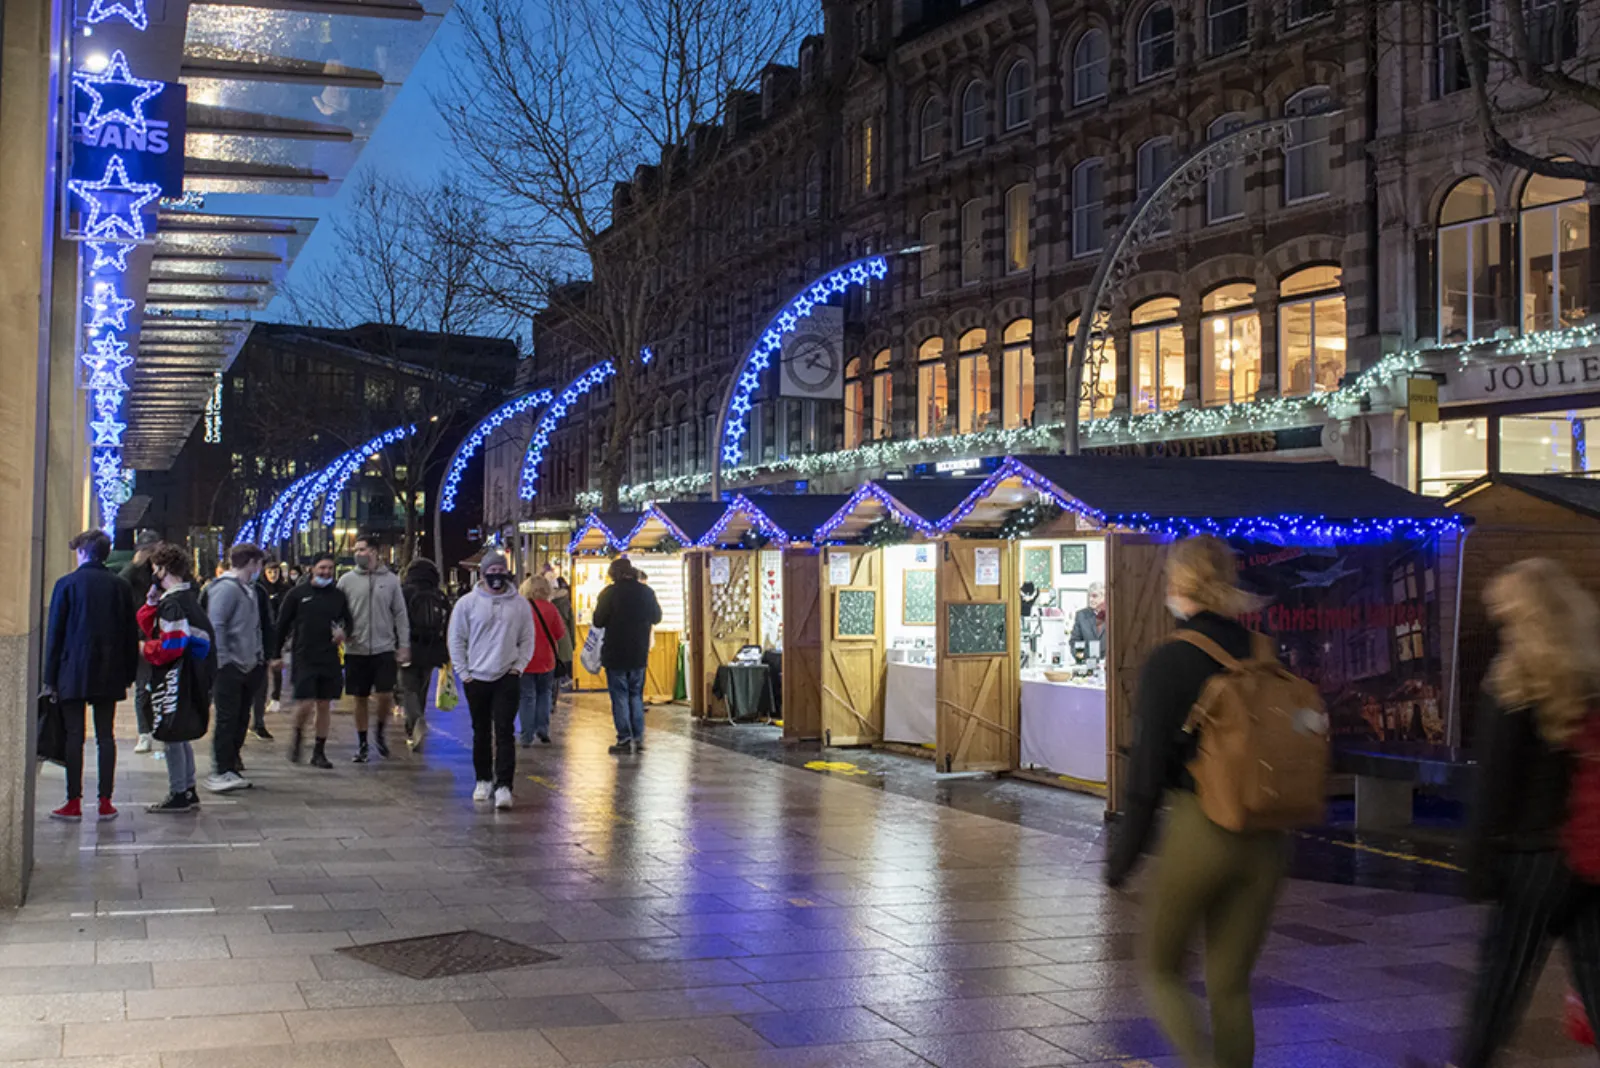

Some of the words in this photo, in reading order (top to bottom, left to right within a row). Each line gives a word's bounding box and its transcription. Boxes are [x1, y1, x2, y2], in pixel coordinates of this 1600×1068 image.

[78, 112, 169, 154] VANS
[1484, 356, 1600, 392] JOULE
[1153, 430, 1277, 458] OUTFITTERS
